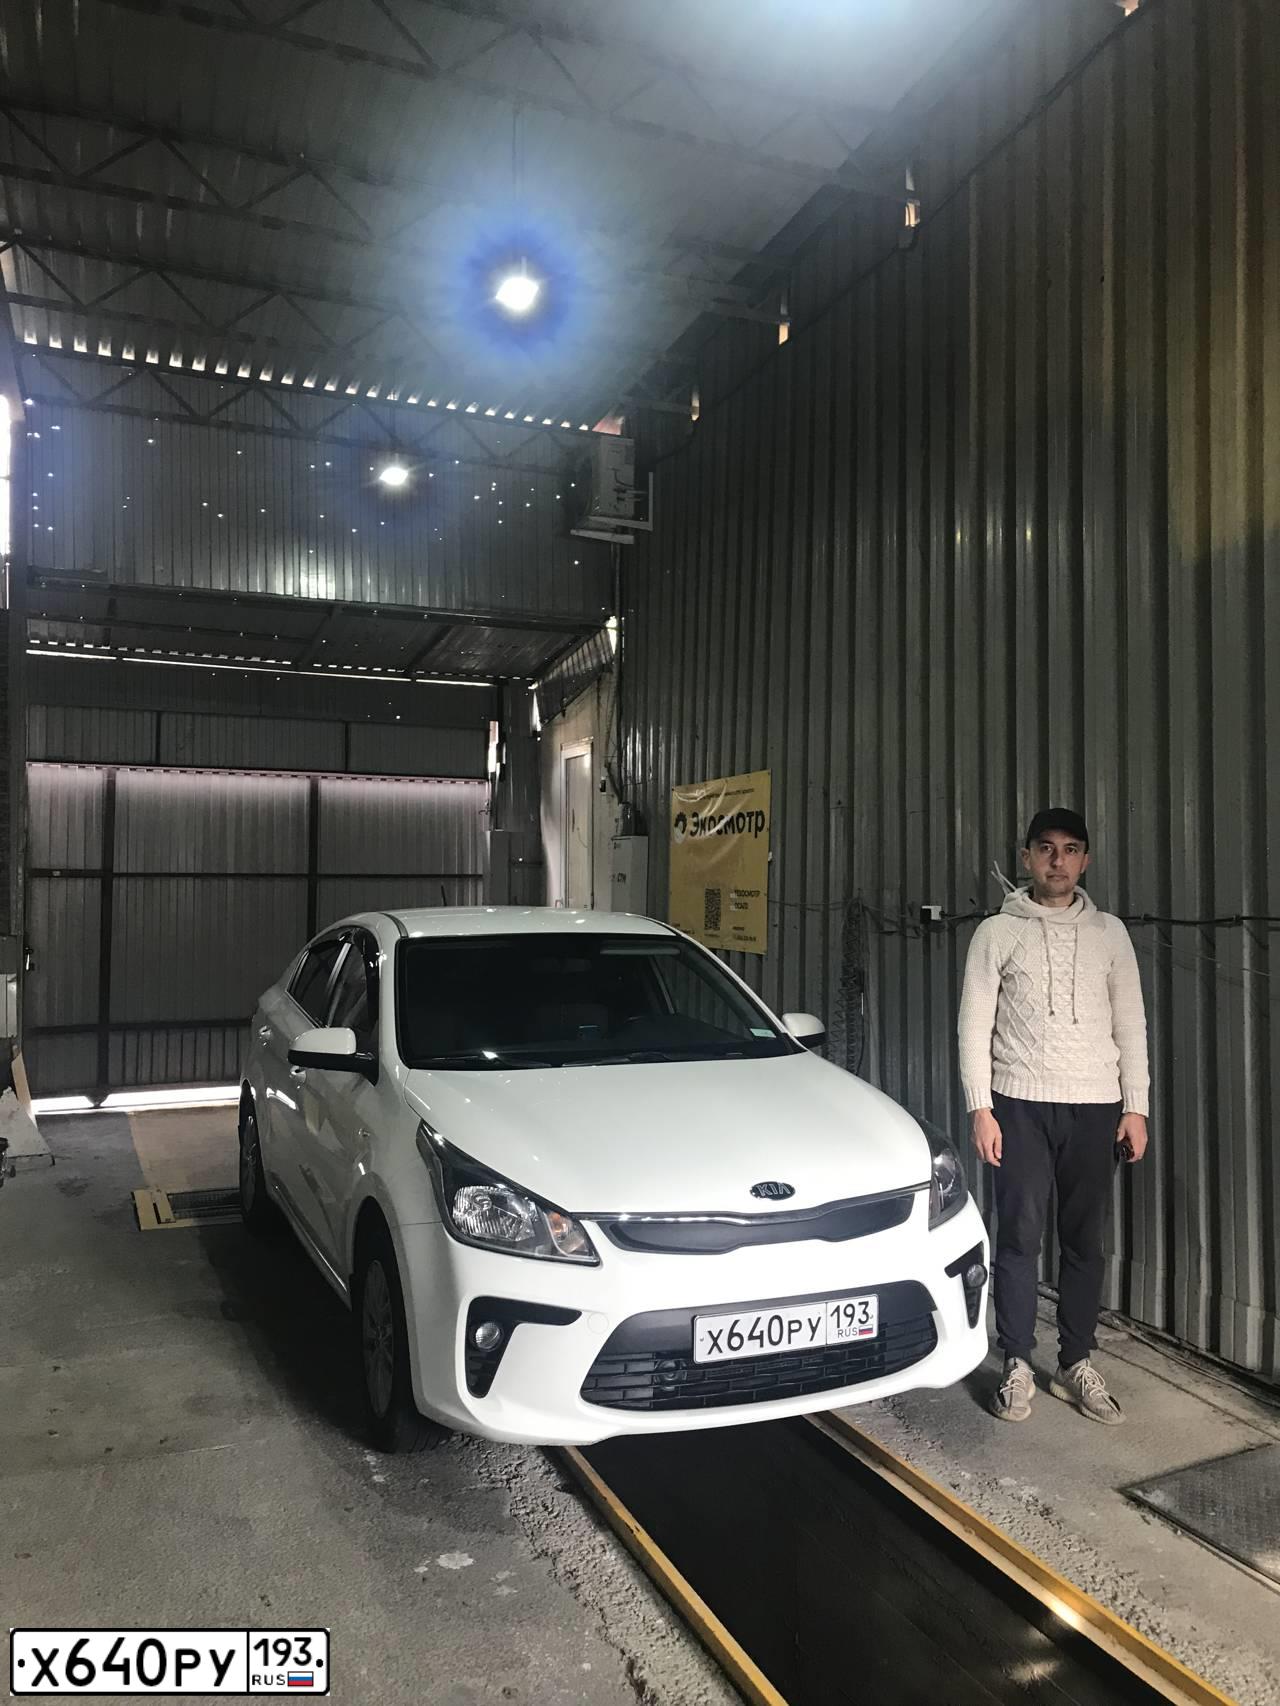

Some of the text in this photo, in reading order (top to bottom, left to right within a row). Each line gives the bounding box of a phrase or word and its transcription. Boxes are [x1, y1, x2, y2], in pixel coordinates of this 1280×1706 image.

[755, 1182, 791, 1197] KIA
[707, 1301, 870, 1355] Х640РУ 193
[837, 1327, 858, 1339] RUS
